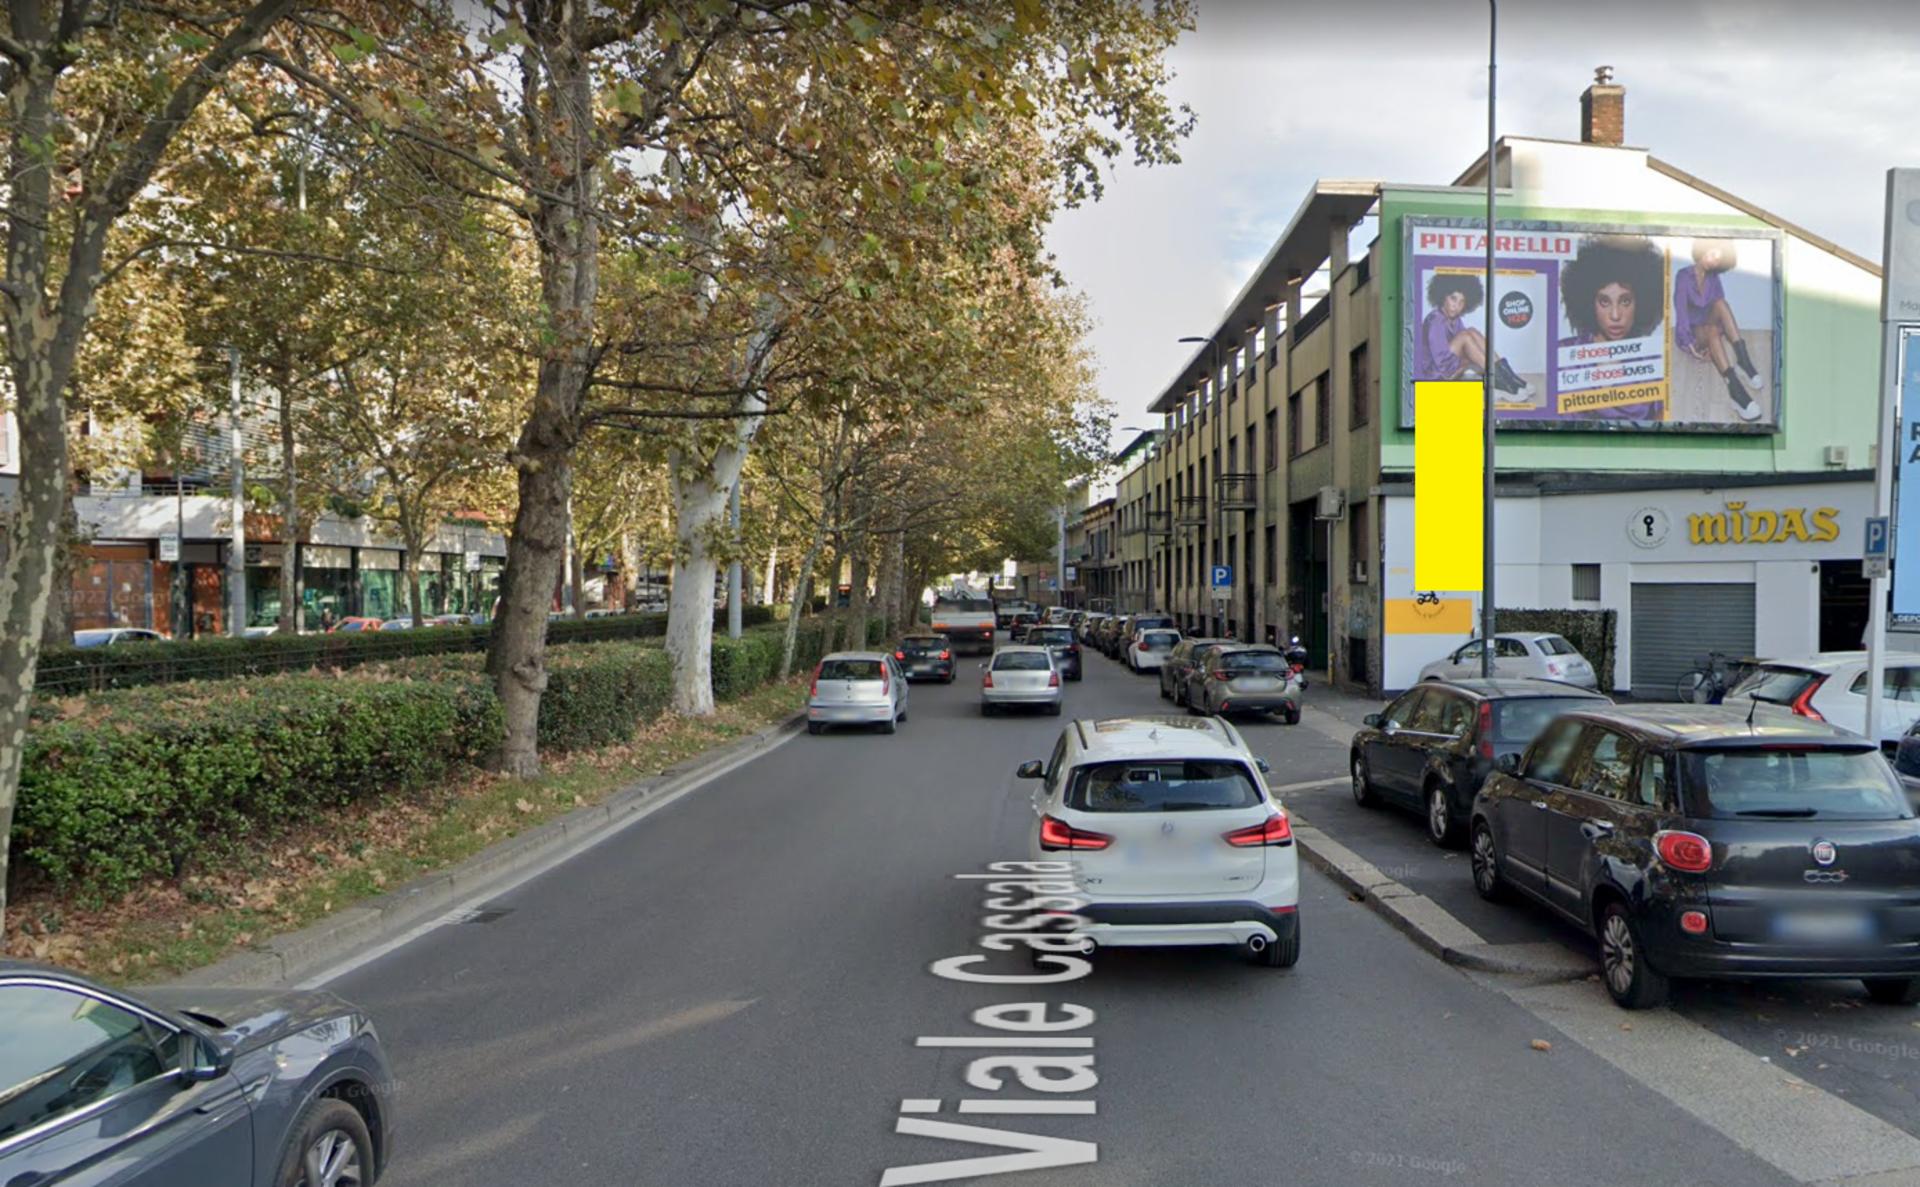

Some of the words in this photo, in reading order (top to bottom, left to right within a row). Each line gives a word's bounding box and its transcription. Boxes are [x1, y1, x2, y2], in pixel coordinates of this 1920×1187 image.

[1420, 233, 1571, 254] PITTARELLO
[1569, 342, 1642, 361] #shoespower
[1561, 371, 1579, 385] for
[1584, 364, 1655, 381] #shoeslovers
[1563, 386, 1660, 411] pittarello.com
[1869, 523, 1882, 551] P
[1215, 568, 1227, 584] P
